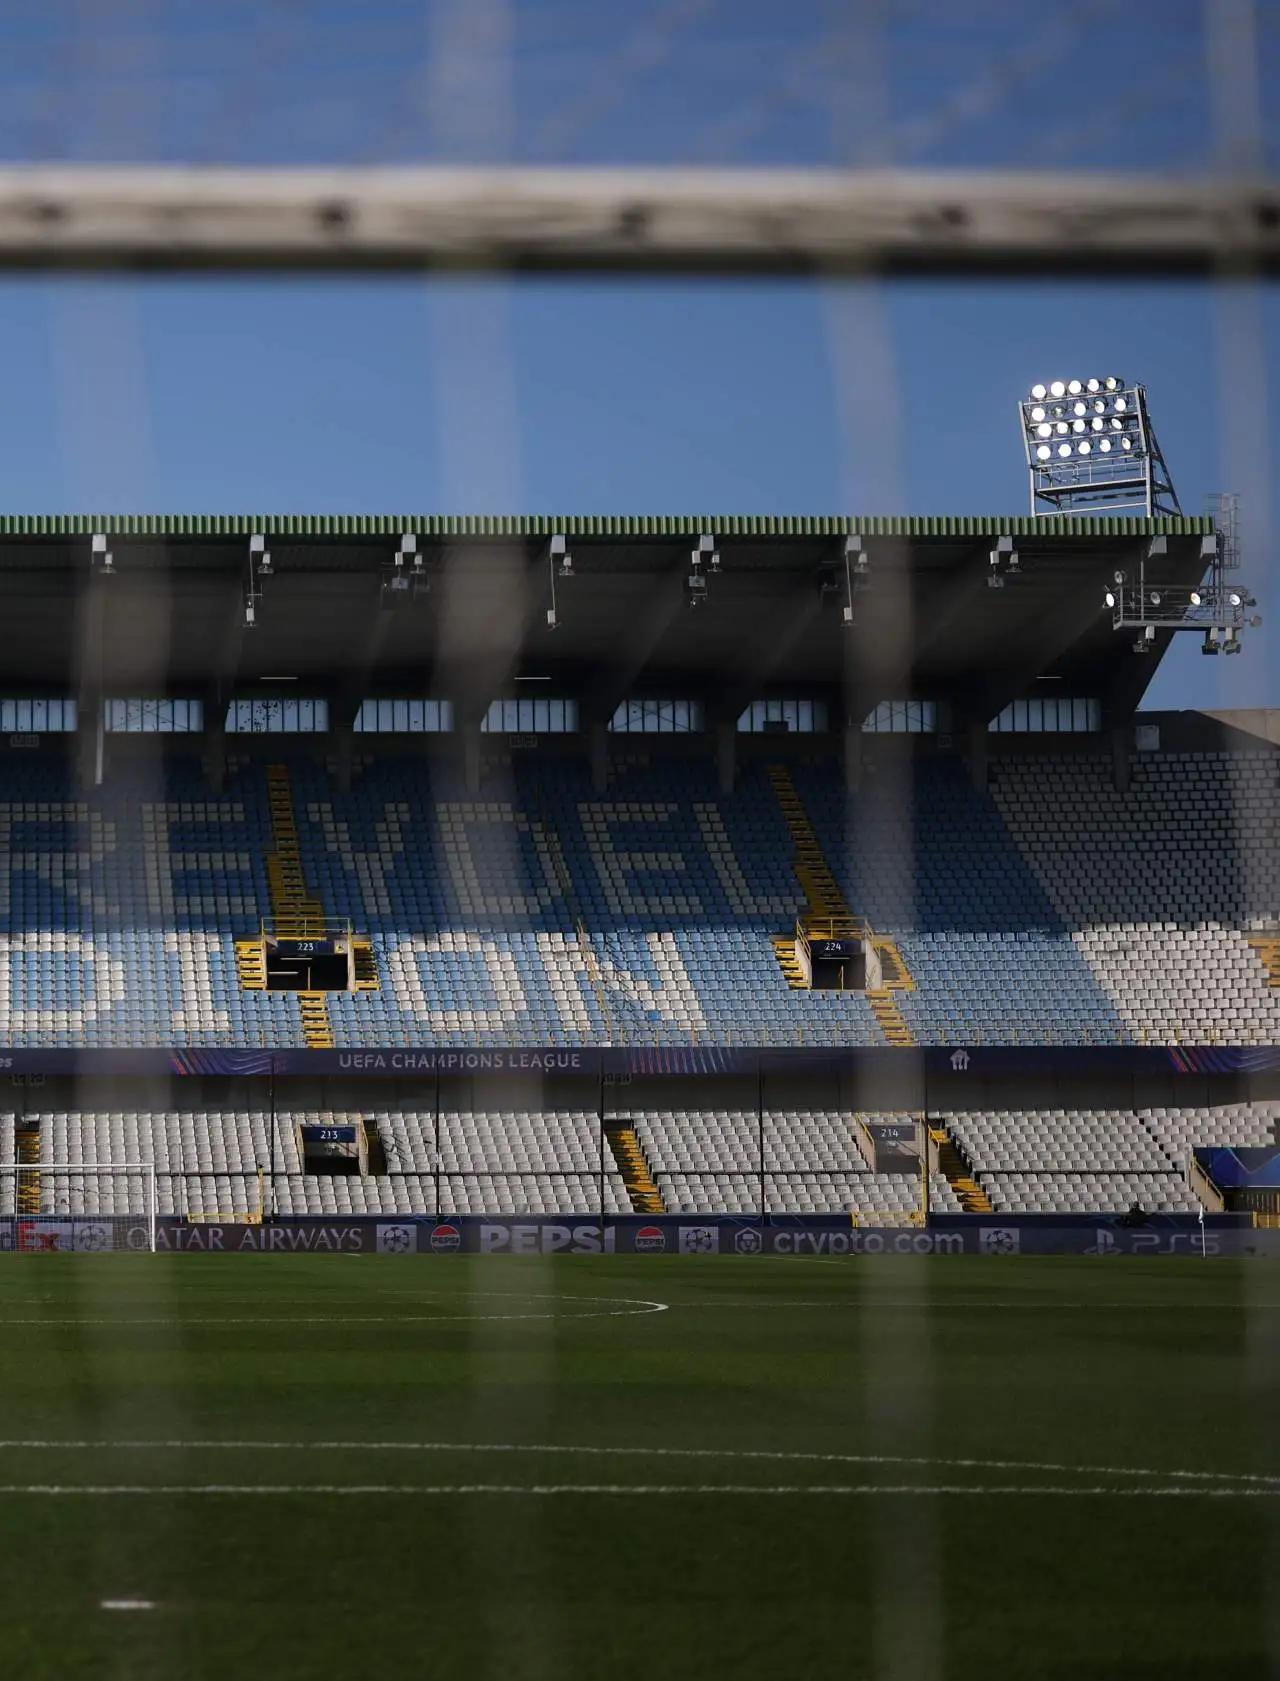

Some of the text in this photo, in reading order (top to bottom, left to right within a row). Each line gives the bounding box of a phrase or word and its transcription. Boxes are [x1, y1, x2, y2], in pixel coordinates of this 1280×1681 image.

[297, 942, 314, 951] 223
[825, 942, 842, 951] 224
[339, 1053, 581, 1068] UEFA CHAMPIONS LEAGUE
[320, 1130, 338, 1140] 213
[881, 1128, 899, 1138] 214
[126, 1227, 363, 1250] QATAR AIRWAYS
[480, 1225, 615, 1254] PEPSI
[773, 1229, 964, 1254] crypto.com
[1131, 1234, 1220, 1254] PS5
